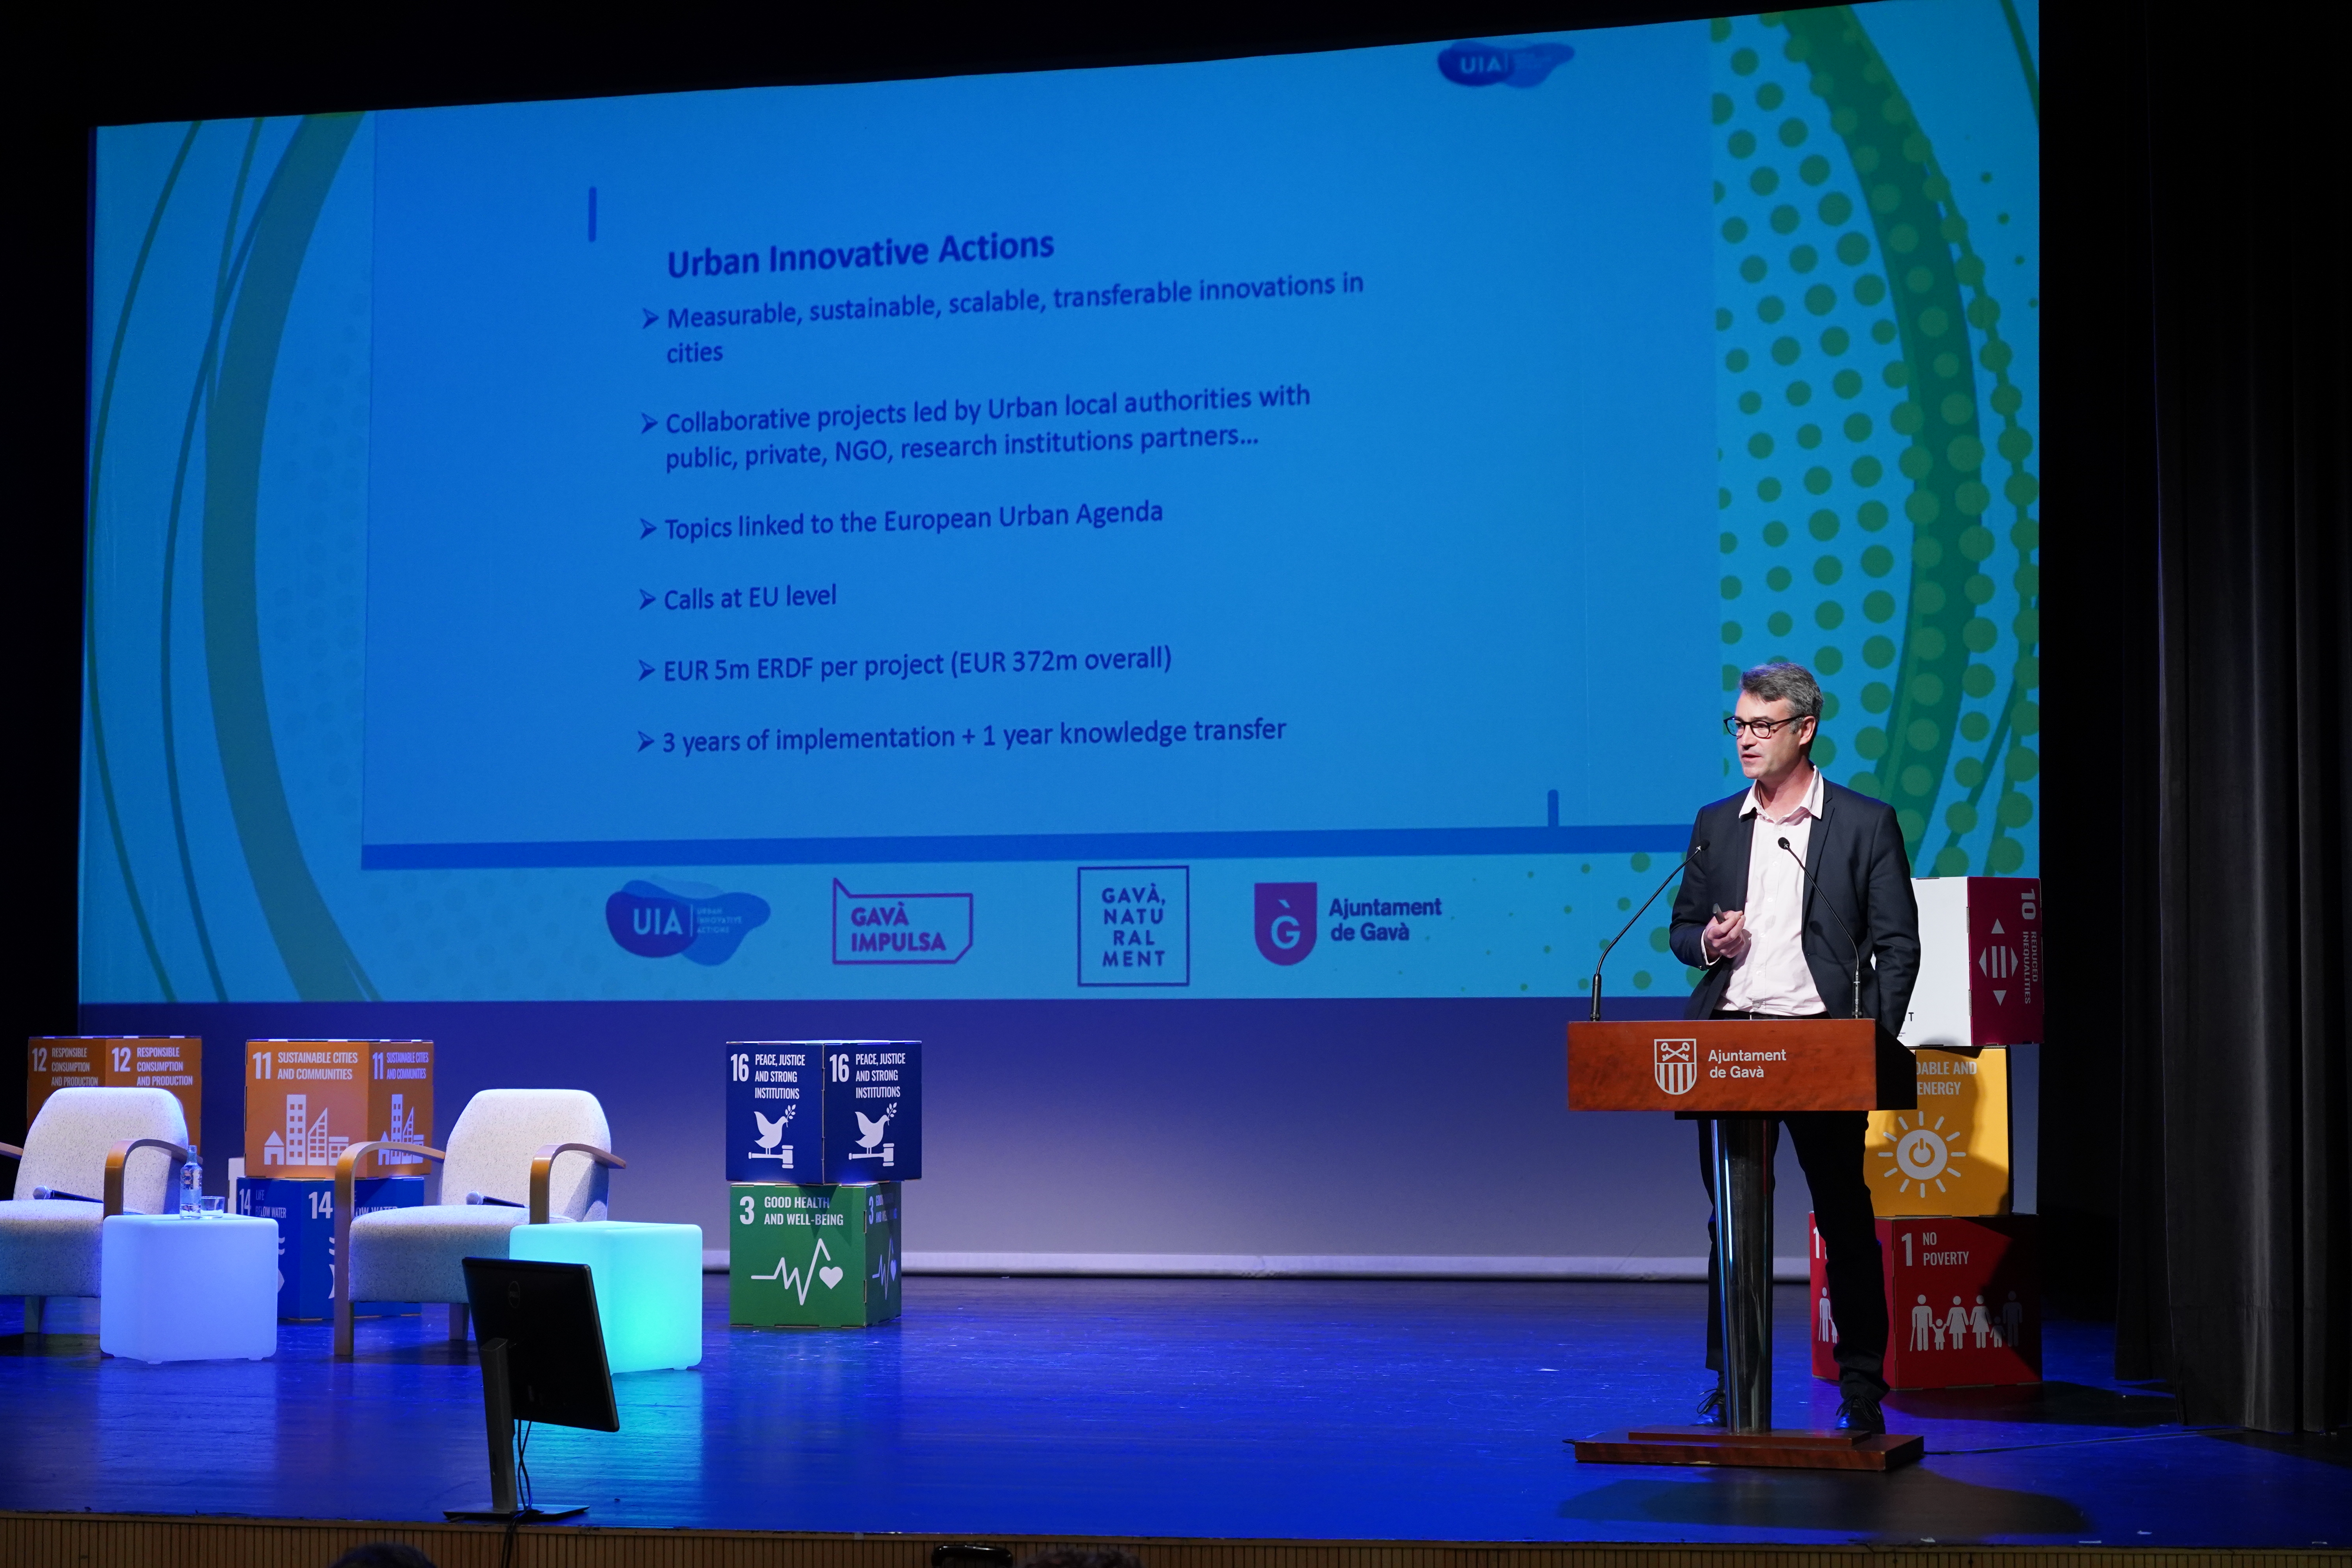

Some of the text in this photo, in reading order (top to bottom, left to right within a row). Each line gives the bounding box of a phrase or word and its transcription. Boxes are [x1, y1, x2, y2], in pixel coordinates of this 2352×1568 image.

[1461, 56, 1501, 74] UIA
[668, 232, 1054, 278] Urban Innovative Actions
[668, 272, 1364, 328] Measurable, sustainable, scalable, transferable innovations in
[667, 342, 723, 364] cities
[666, 383, 1310, 434] Collaborative projects led by Urban local authorities with
[666, 446, 738, 474] public,
[746, 444, 827, 470] private,
[835, 439, 894, 463] NGO,
[901, 434, 997, 459] research
[1005, 430, 1133, 454] institutions
[665, 499, 1163, 543] Topics linked to the European Urban Agenda
[664, 583, 837, 610] Calls at EU level
[664, 645, 1172, 682] EUR 5m ERDF per project (EUR 372m overall)
[663, 717, 1287, 757] 3 years of implementation + 1 year knowledge transfer
[1102, 883, 1165, 906] GAVÀ,
[1329, 897, 1442, 920] Ajuntament
[2021, 888, 2036, 920] 10
[633, 907, 683, 935] UIA
[851, 902, 909, 927] GAVÀ
[1104, 908, 1163, 925] NATU
[1113, 930, 1155, 946] RAL
[1331, 922, 1409, 941] de Gavà
[851, 932, 946, 952] IMPULSA
[1103, 951, 1165, 967] MENT
[32, 1047, 47, 1072] 12
[52, 1047, 87, 1058] RESPONSIBLE
[112, 1047, 131, 1072] 12
[137, 1047, 180, 1057] RESPONSIBLE
[278, 1052, 358, 1063] SUSTAINABLE CITIES
[387, 1052, 428, 1063] SUSTAINABLE CITIES
[755, 1054, 805, 1067] PEACE, JUSTICE
[856, 1053, 906, 1066] PEACE, JUSTICE
[1708, 1049, 1786, 1063] Ajuntament
[52, 1062, 90, 1072] CONSUMPTION
[137, 1062, 183, 1072] CONSUMPTION
[253, 1052, 271, 1079] 11
[372, 1052, 383, 1080] 11
[387, 1068, 426, 1079] AND COMMUNITIES
[731, 1053, 749, 1082] 16
[829, 1054, 849, 1082] 16
[1710, 1066, 1764, 1078] de Gavà
[1953, 1062, 1977, 1075] AND
[51, 1076, 98, 1086] AND PRODUCTION
[137, 1075, 193, 1086] AND PRODUCTION
[278, 1069, 352, 1080] AND COMMUNITIES
[755, 1071, 797, 1082] AND STRONG
[856, 1070, 898, 1082] AND STRONG
[755, 1087, 800, 1099] INSTITUTIONS
[856, 1086, 900, 1098] INSTITUTIONS
[1917, 1082, 1961, 1095] ENERGY
[239, 1189, 251, 1215] 14
[256, 1190, 265, 1200] LIFE
[764, 1197, 829, 1209] GOOD HEALTH
[255, 1206, 287, 1218] BELOW WATER
[309, 1191, 333, 1219] 14
[740, 1196, 754, 1225] 3
[869, 1196, 873, 1224] 3
[764, 1214, 843, 1225] AND WELL-BEING
[1813, 1226, 1820, 1258] 1
[1922, 1232, 1936, 1245] NO
[1902, 1233, 1913, 1266] 1
[1923, 1251, 1969, 1266] POVERTY
